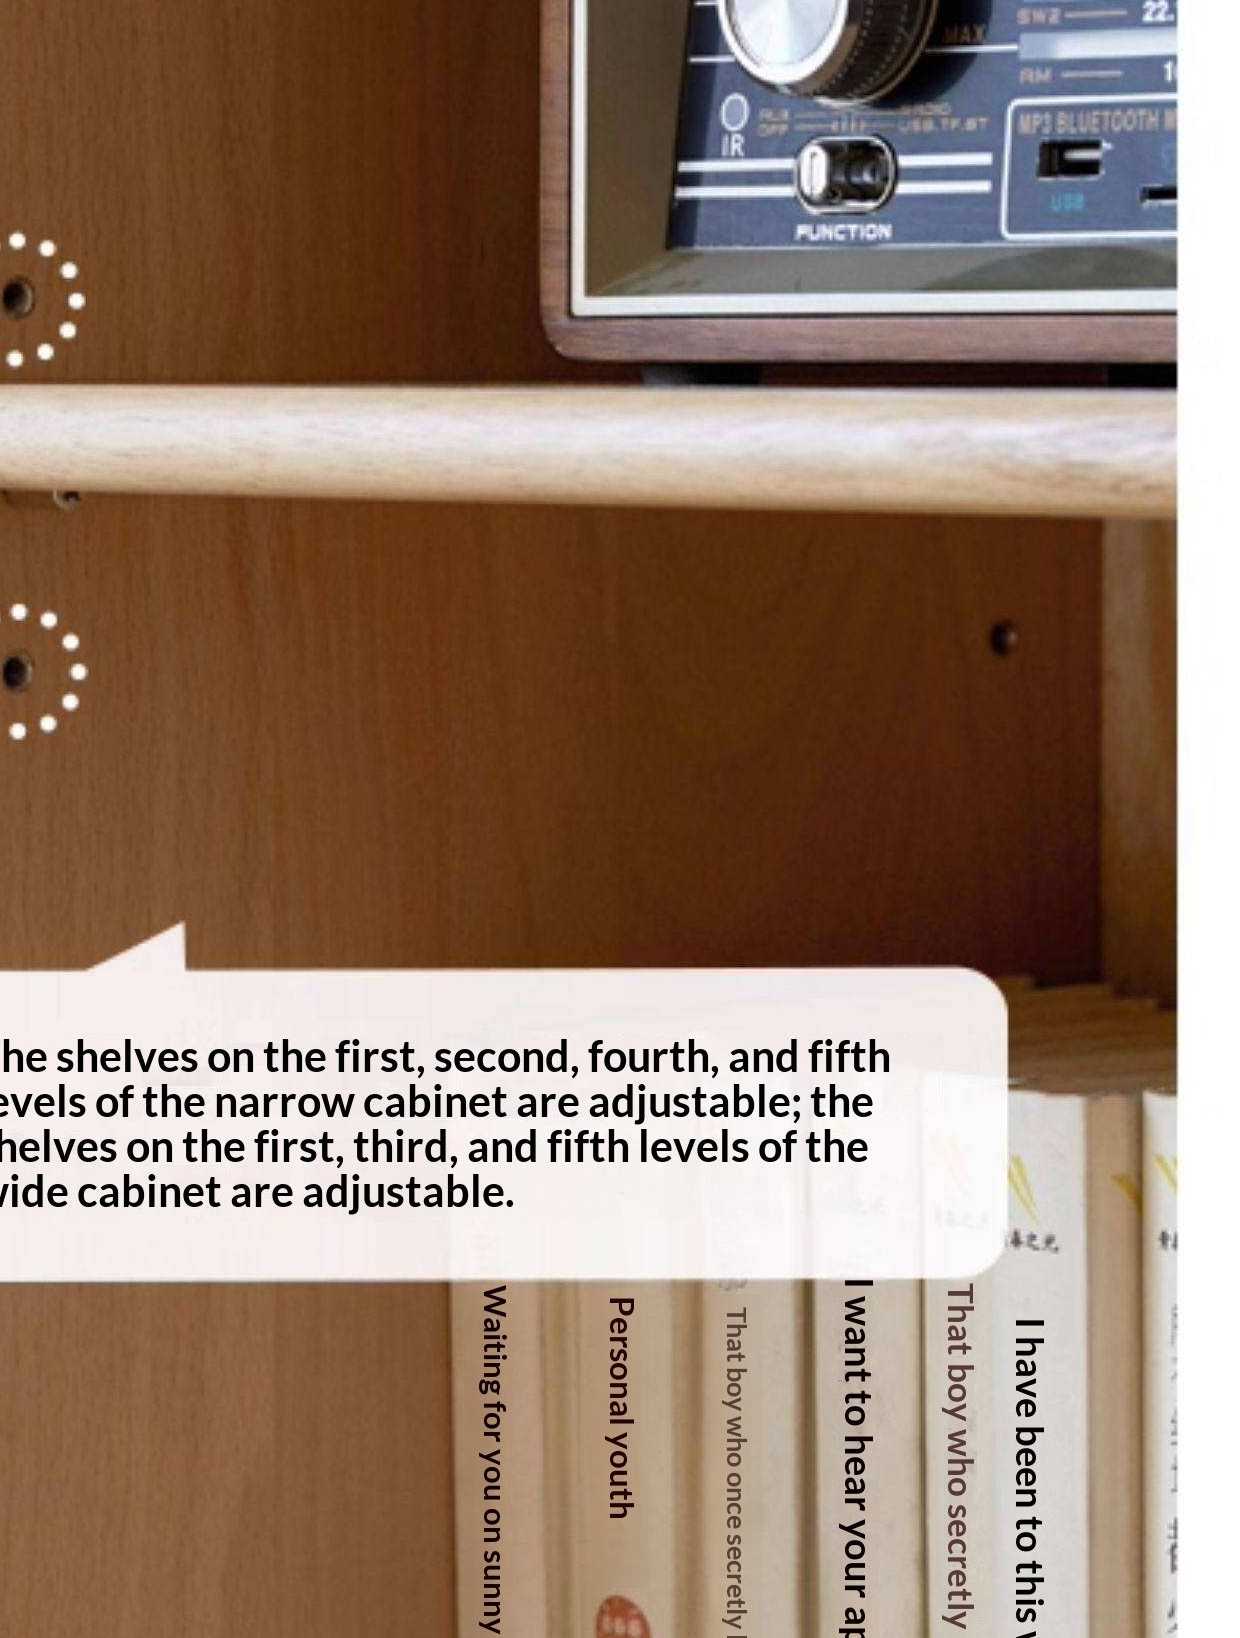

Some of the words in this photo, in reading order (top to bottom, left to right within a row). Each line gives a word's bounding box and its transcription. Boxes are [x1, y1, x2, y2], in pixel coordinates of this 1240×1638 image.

[1057, 107, 1159, 134] BLUETOOTH
[721, 134, 745, 157] IR
[794, 223, 893, 242] FUNCTION
